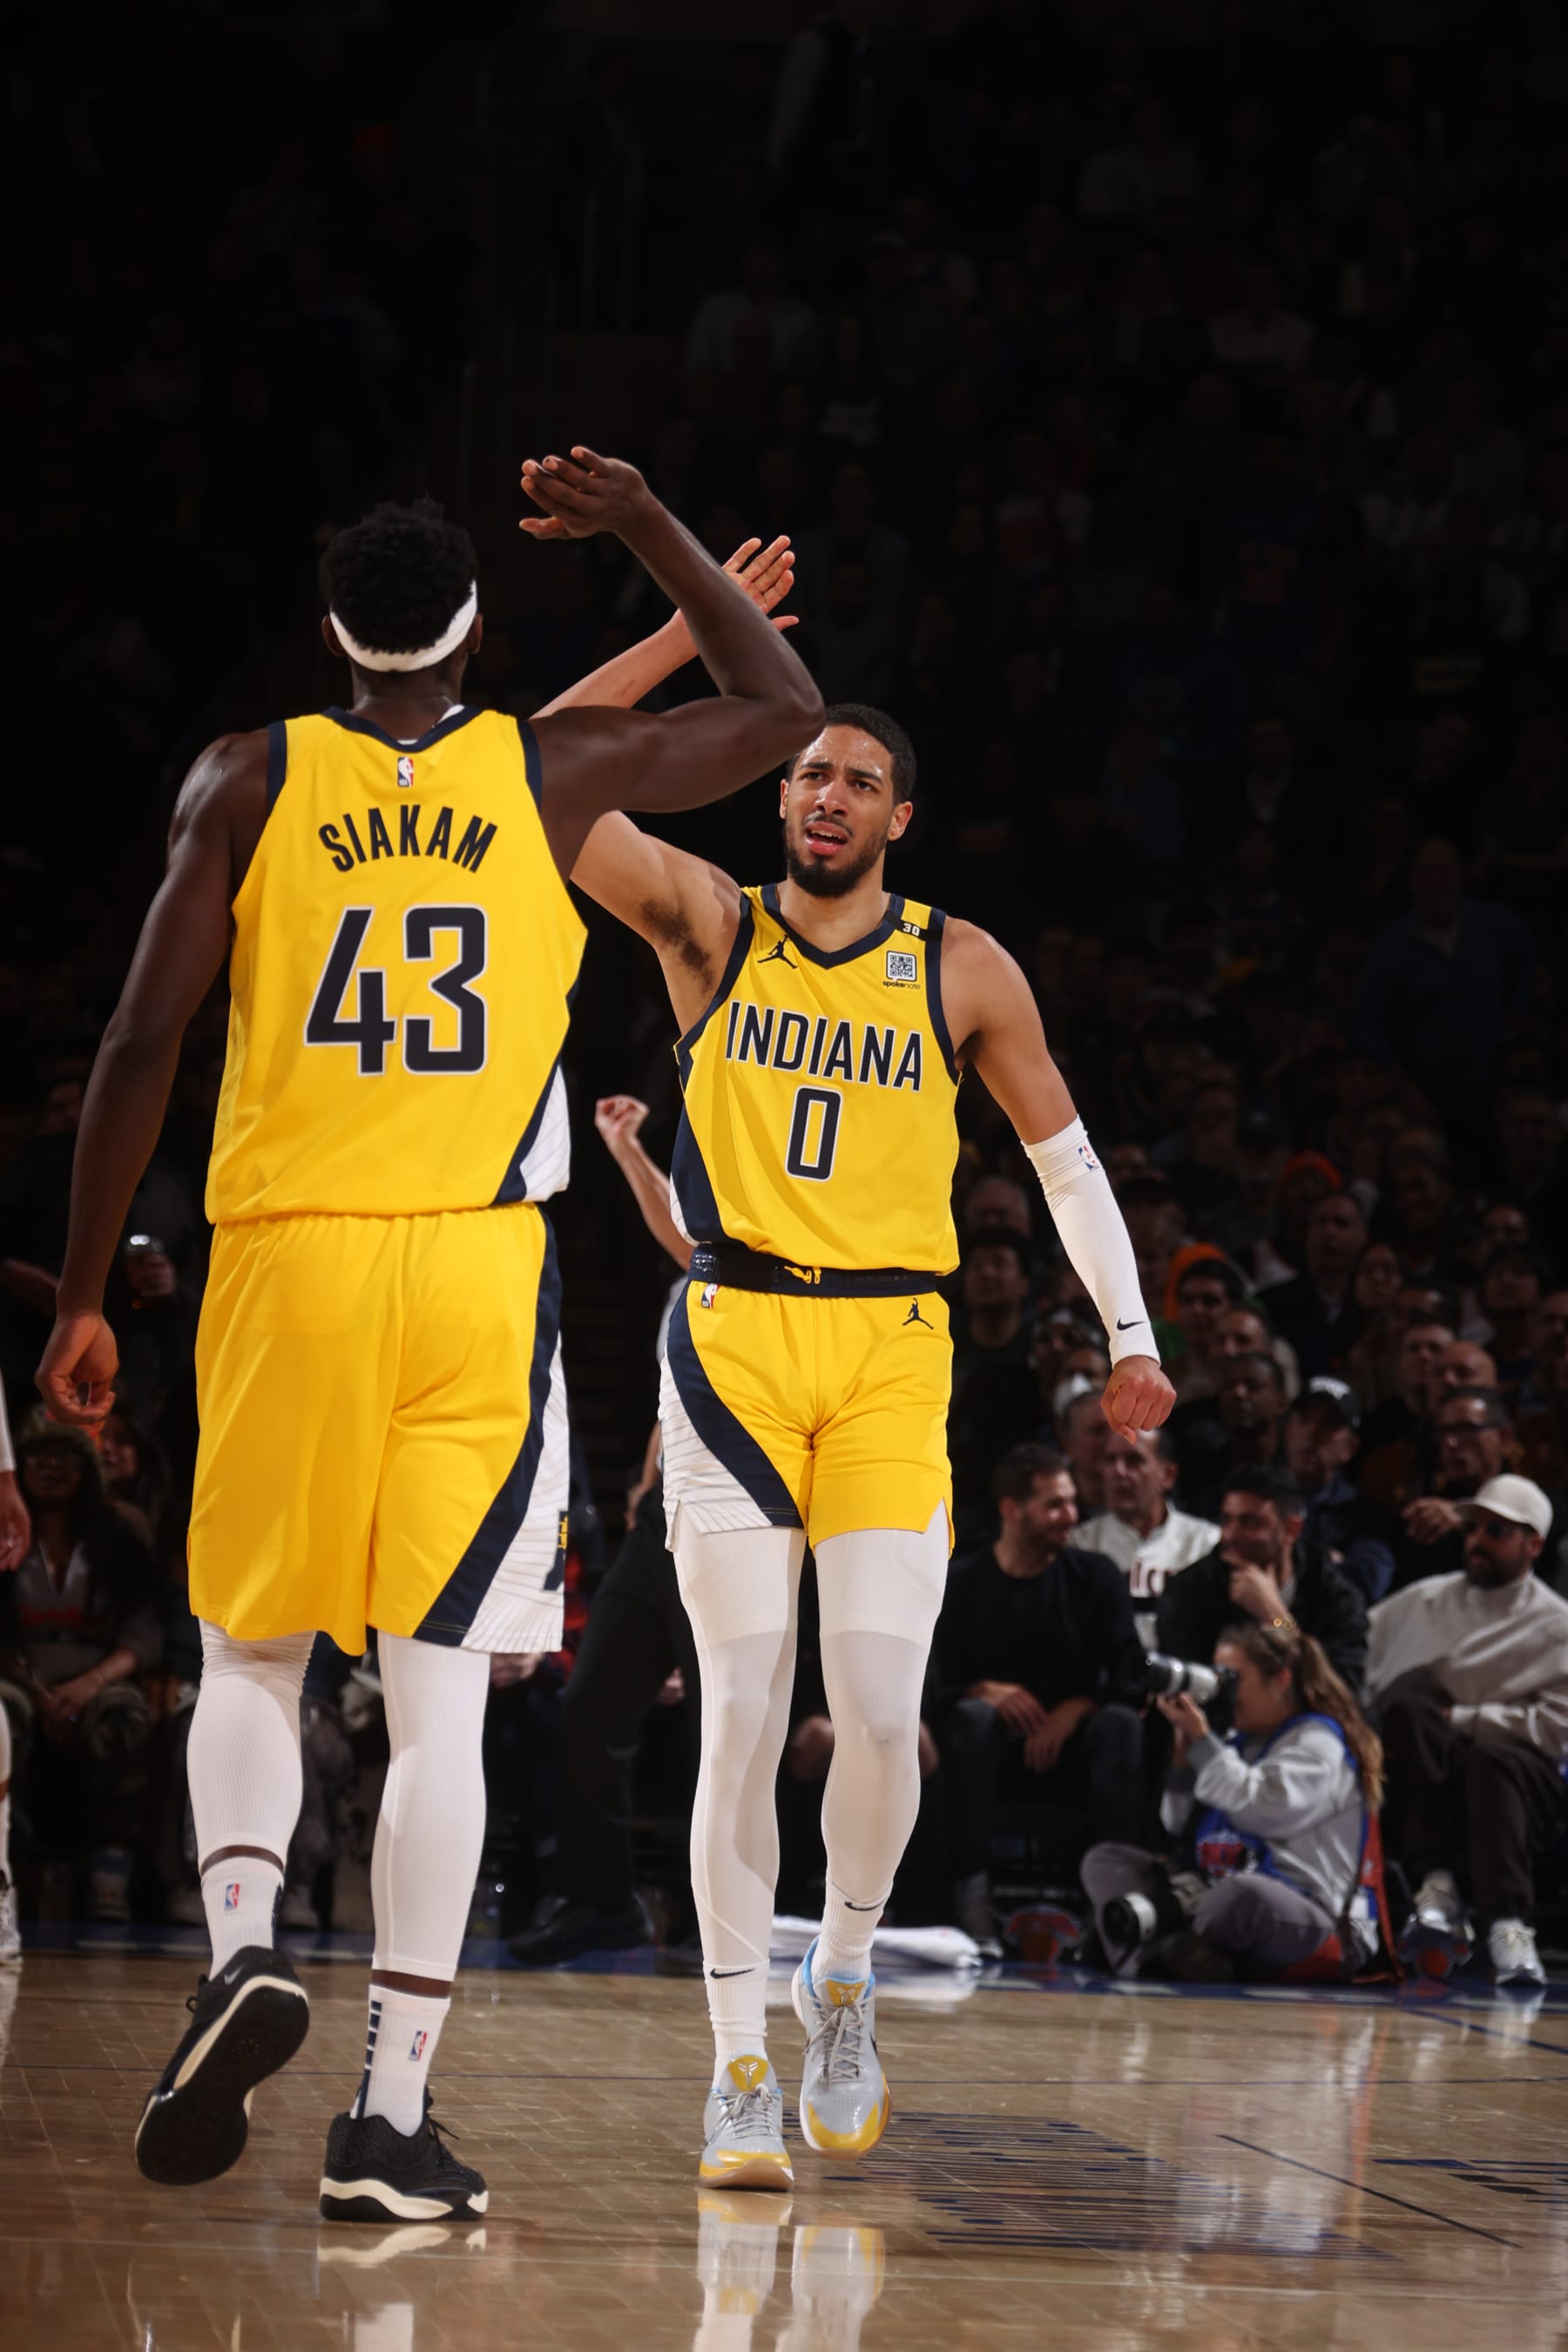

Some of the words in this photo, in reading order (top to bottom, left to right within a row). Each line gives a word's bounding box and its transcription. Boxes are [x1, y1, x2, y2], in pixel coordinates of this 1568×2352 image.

[319, 804, 497, 873] SIAKAM
[902, 923, 920, 936] 30
[304, 903, 488, 1077] 43
[882, 980, 921, 990] spokenote
[726, 1000, 923, 1092] INDIANA
[786, 1086, 842, 1181] 0
